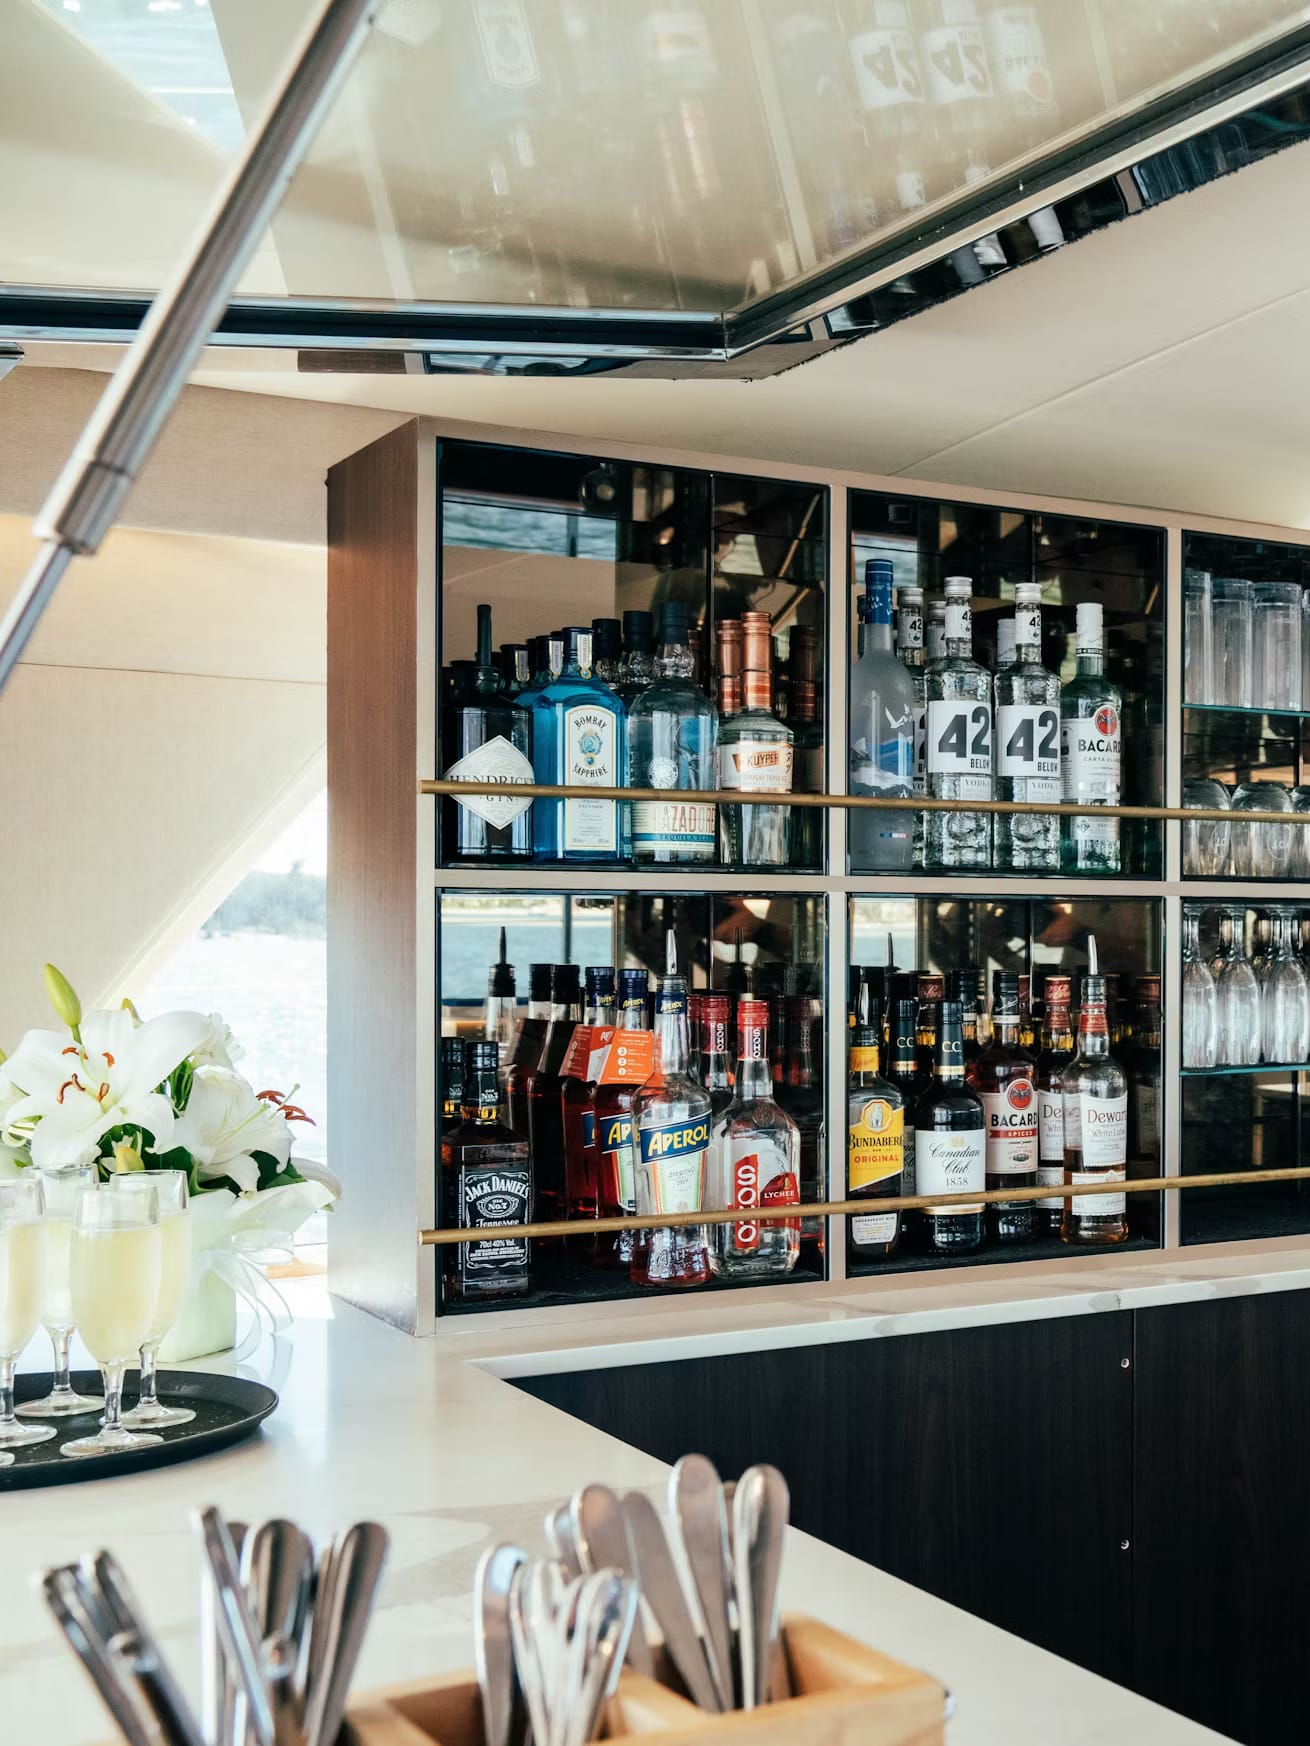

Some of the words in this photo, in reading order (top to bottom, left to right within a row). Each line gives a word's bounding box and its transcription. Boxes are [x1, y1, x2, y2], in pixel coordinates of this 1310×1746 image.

[574, 715, 607, 729] BOMBAY
[938, 706, 990, 758] 42
[1006, 710, 1058, 762] 42
[573, 763, 608, 778] SAPPHIRE
[449, 775, 534, 785] HENDRICK
[655, 805, 715, 833] AZADORE
[716, 1022, 725, 1051] SOHO
[752, 1028, 761, 1058] SOHO
[648, 1124, 709, 1157] APEROL
[929, 1142, 981, 1158] Canadian
[854, 1154, 900, 1164] ORIGINAL
[941, 1159, 972, 1174] Club
[465, 1180, 492, 1202] JACK
[492, 1175, 529, 1199] DANIEL'S
[946, 1177, 969, 1187] 1858
[764, 1190, 795, 1199] LYCHEE
[476, 1218, 520, 1228] Tennessee
